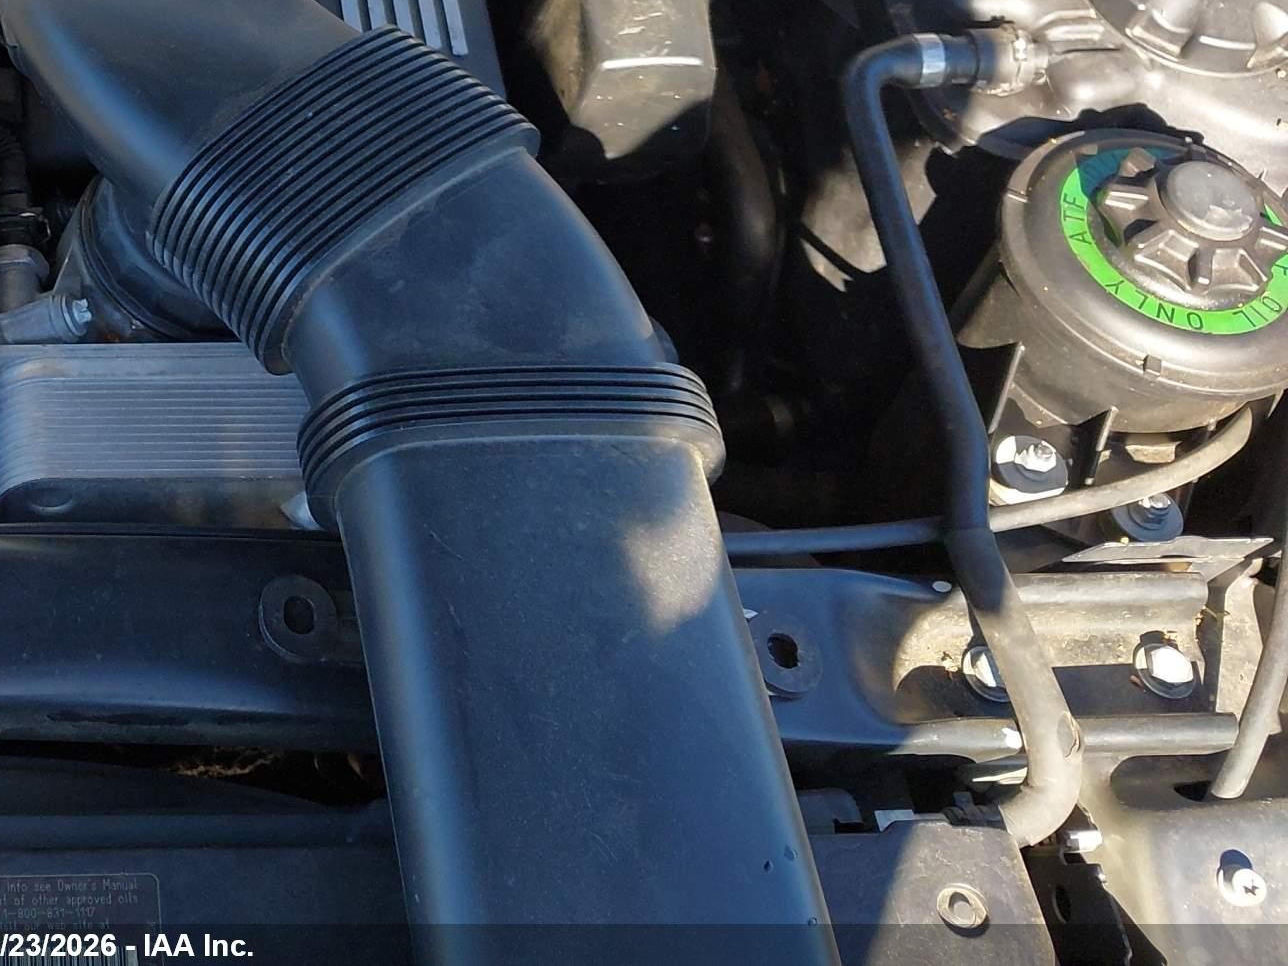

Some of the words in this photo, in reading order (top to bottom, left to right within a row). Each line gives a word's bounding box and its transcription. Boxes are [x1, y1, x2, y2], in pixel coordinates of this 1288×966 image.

[1062, 193, 1096, 246] ATF
[1104, 279, 1204, 331] ONLY
[1231, 295, 1283, 329] OIL
